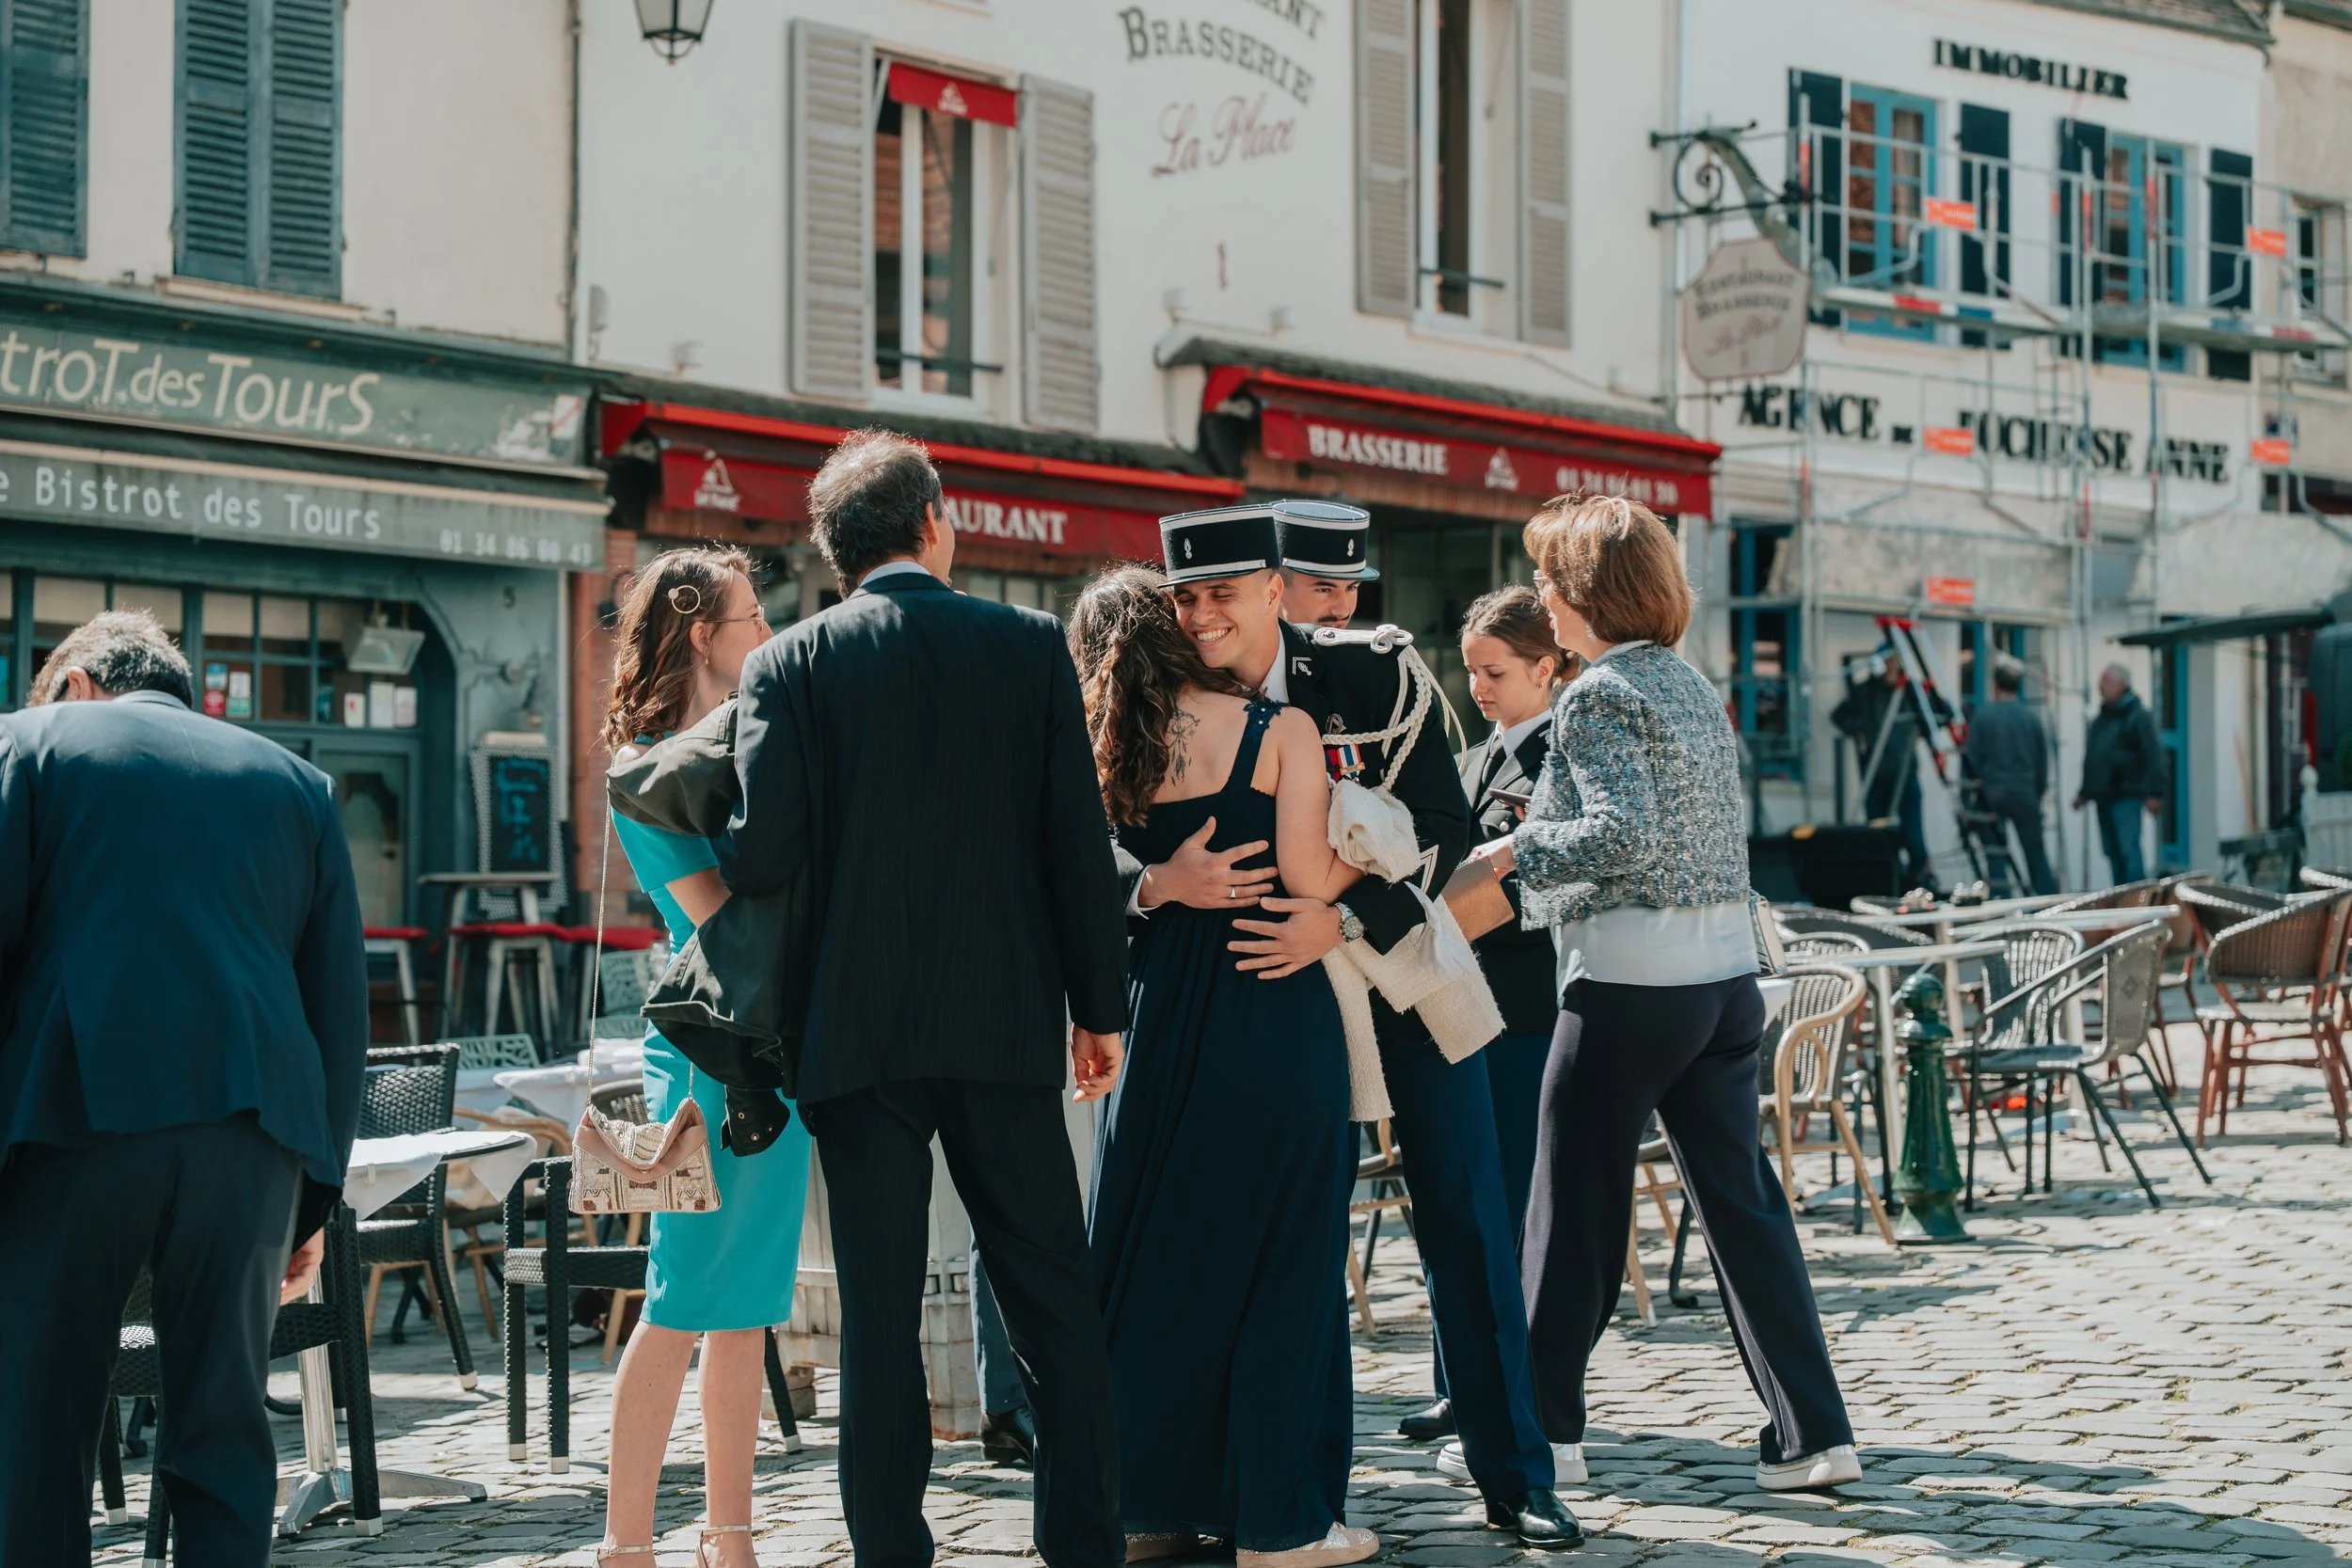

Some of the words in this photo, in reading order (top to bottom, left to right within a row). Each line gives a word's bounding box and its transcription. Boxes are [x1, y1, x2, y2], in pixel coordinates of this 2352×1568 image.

[1117, 6, 1315, 105] BRASSERIE
[1933, 39, 2129, 100] IMMOBILIER
[130, 353, 206, 408] des
[1738, 382, 1882, 441] AGENCE
[1307, 423, 1451, 476] BRASSERIE
[35, 466, 184, 519] Bistrot
[203, 486, 262, 530] des
[284, 493, 382, 540] Tours
